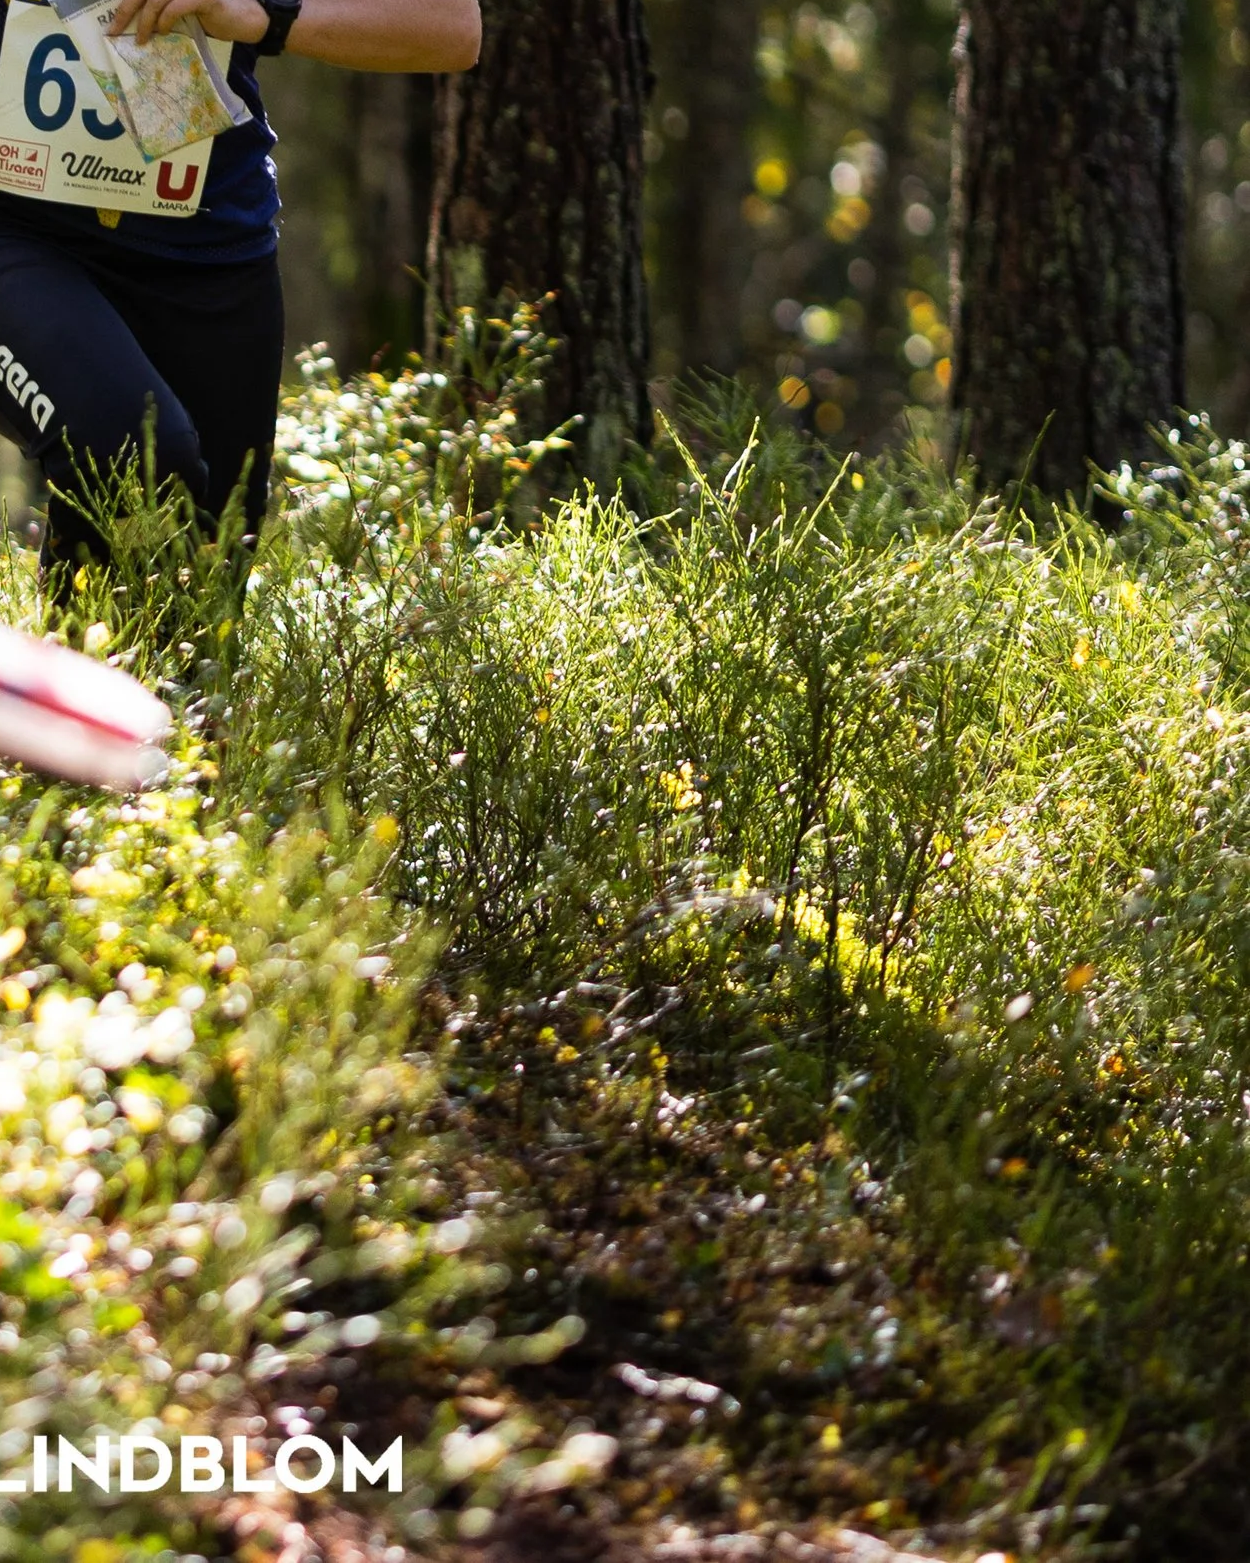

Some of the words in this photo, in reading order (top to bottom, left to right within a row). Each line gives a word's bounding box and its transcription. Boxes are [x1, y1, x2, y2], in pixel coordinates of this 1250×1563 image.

[61, 151, 146, 186] Ullmax
[156, 160, 199, 201] U
[152, 200, 190, 212] UMARA
